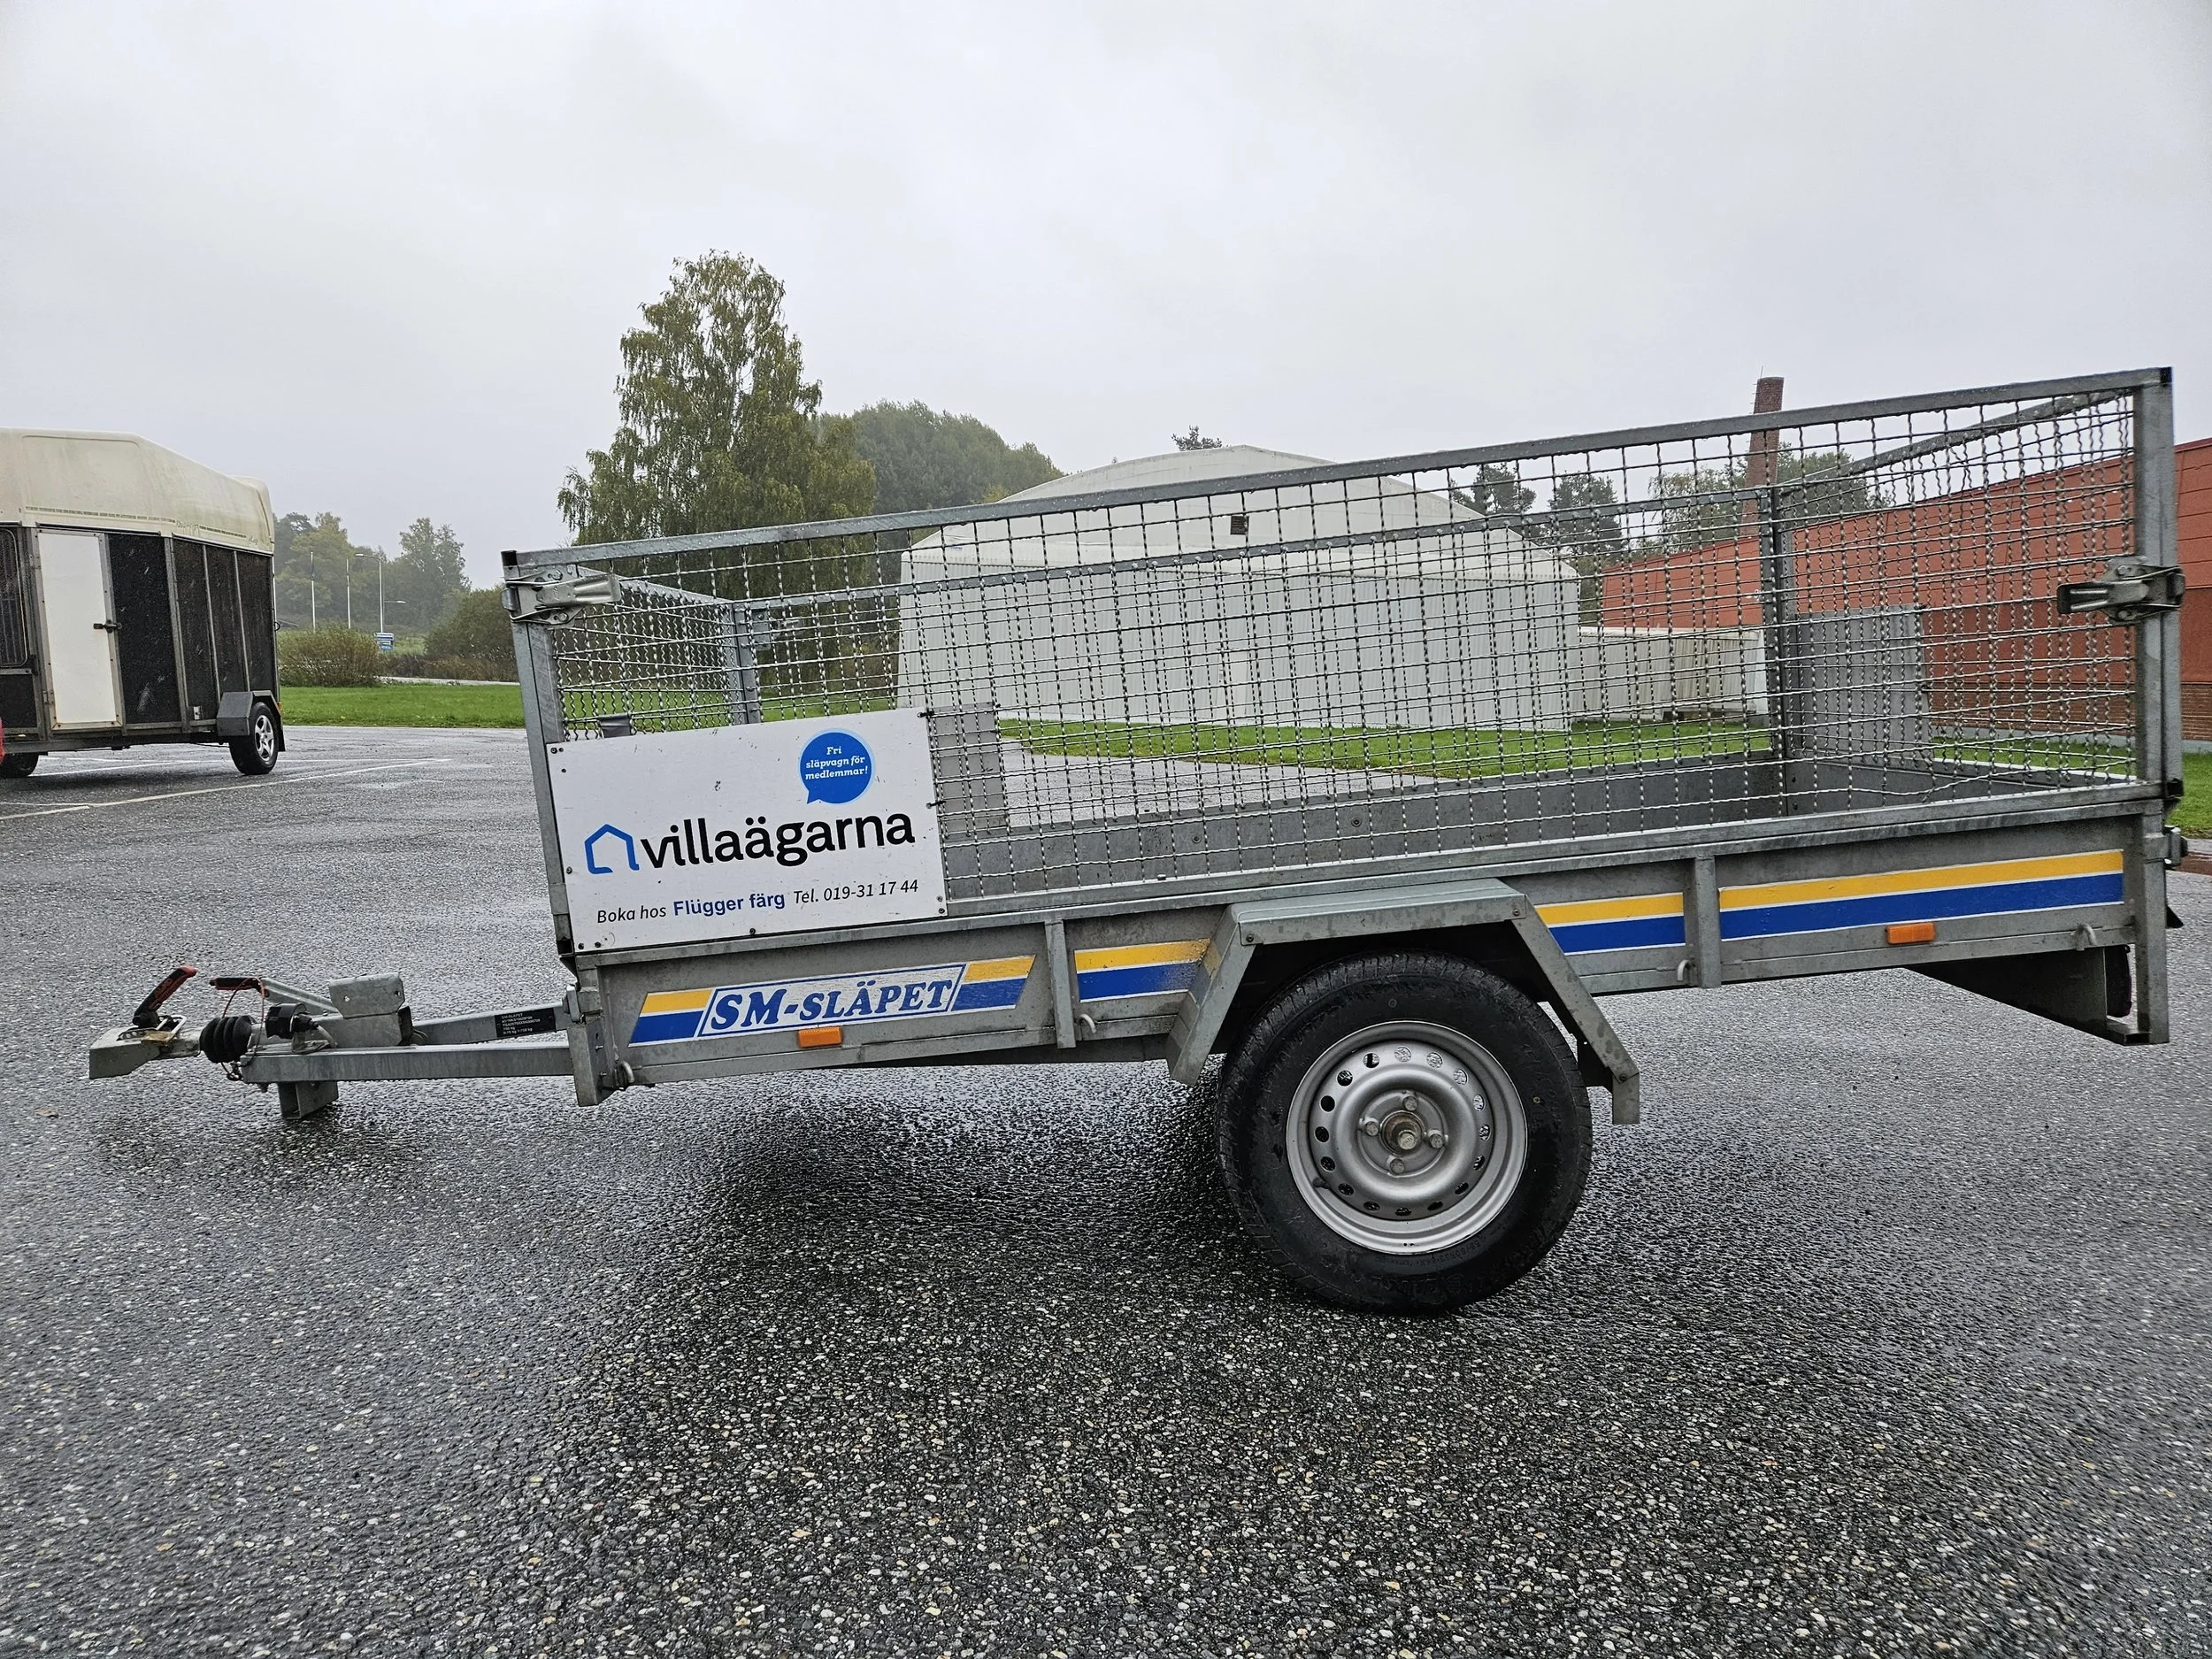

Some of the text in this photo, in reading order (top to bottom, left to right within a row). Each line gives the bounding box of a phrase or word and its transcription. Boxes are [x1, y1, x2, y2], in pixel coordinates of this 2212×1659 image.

[806, 756, 865, 769] släpvagn för
[826, 746, 841, 755] Fri
[805, 765, 868, 780] medlemmar!
[641, 812, 915, 868] villaägarna
[597, 879, 919, 924] Boka hos Flügger färg Tel. 019-31 17 44
[710, 979, 953, 1031] SM-SLÄPET
